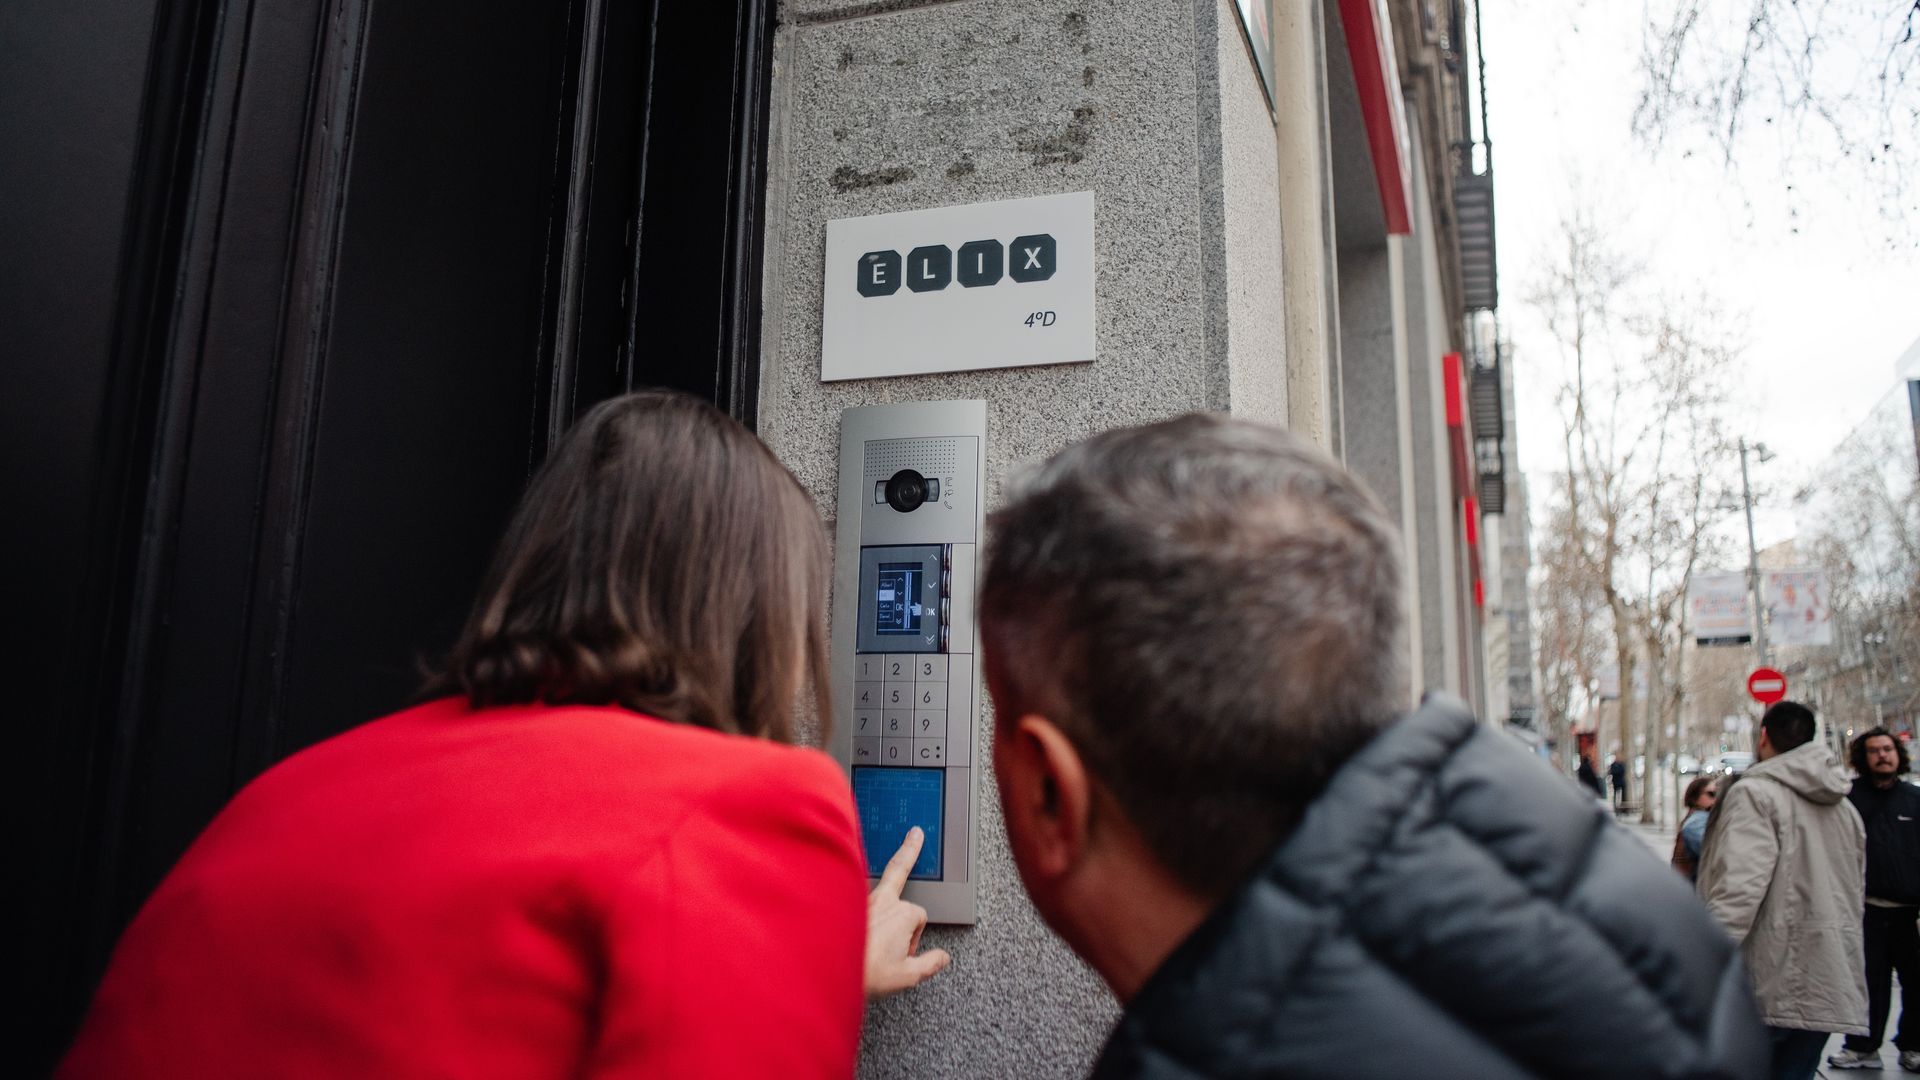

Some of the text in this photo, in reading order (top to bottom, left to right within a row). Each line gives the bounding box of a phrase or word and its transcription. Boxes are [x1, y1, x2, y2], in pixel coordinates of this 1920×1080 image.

[870, 245, 1043, 286] ELIX
[925, 608, 936, 616] OK
[863, 662, 932, 675] 1 2 3
[862, 690, 931, 703] 4 5 6
[860, 718, 930, 731] 7 8 9
[889, 746, 930, 759] 0 C
